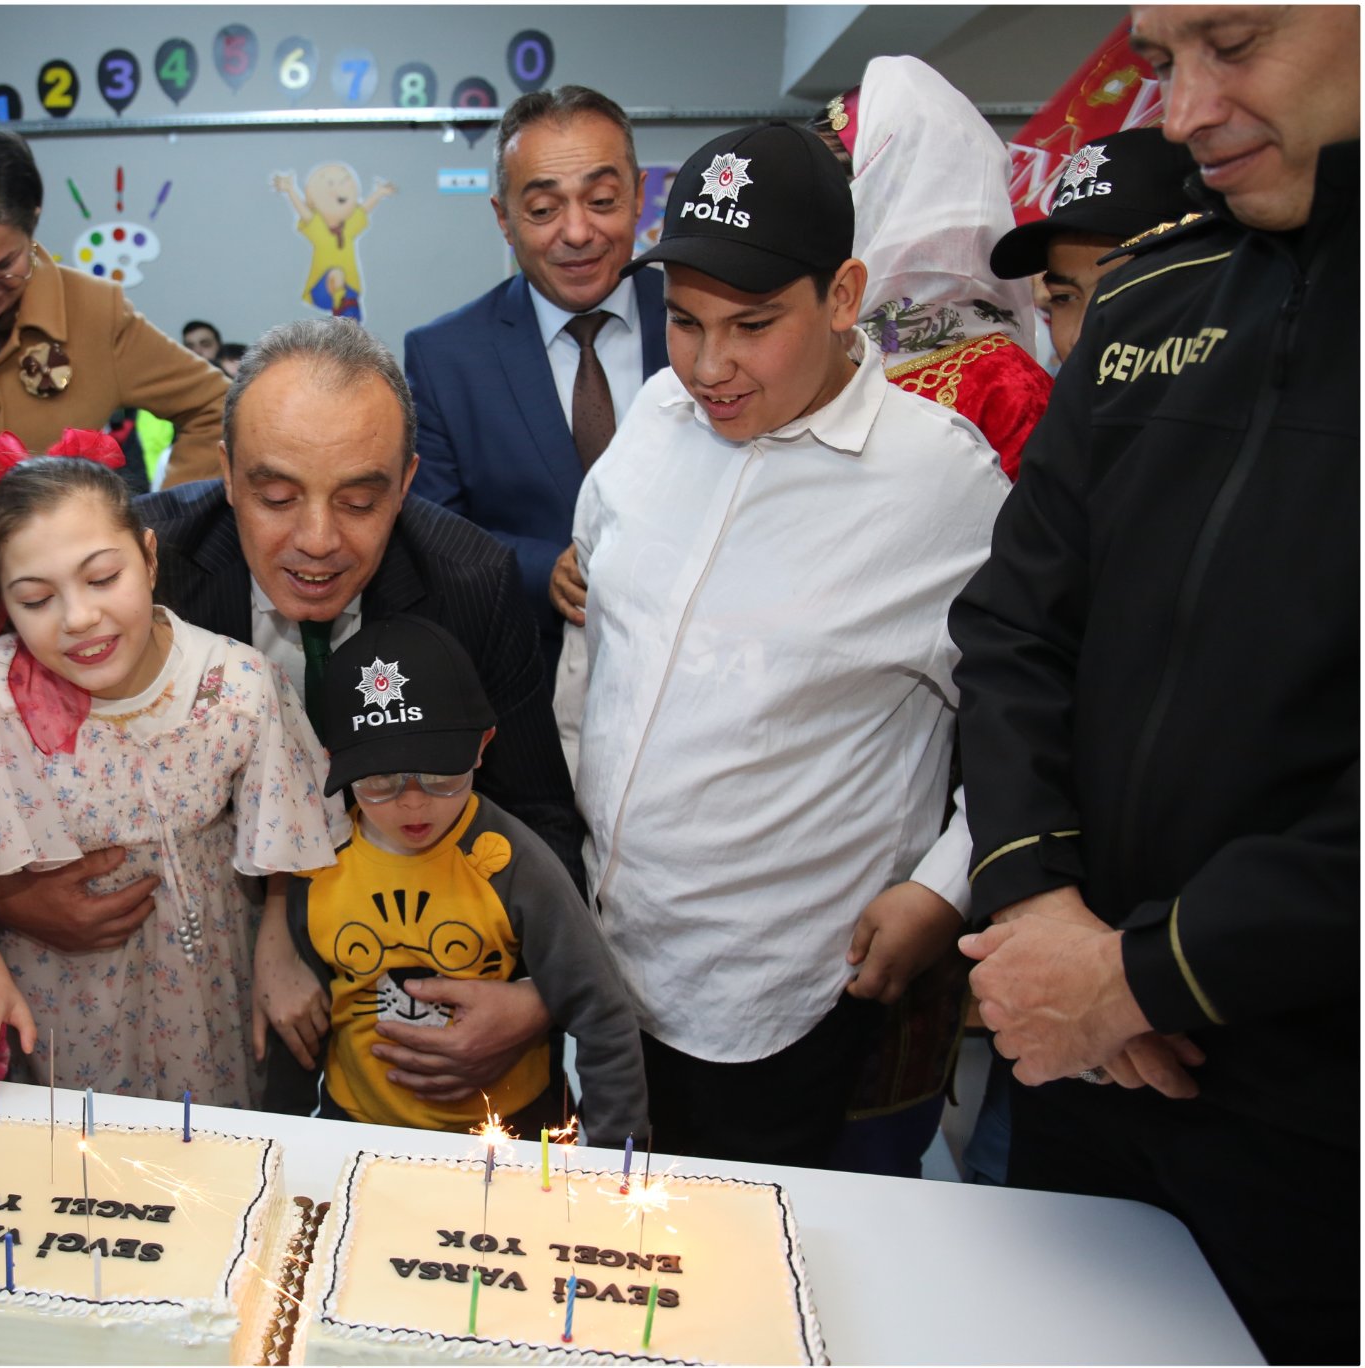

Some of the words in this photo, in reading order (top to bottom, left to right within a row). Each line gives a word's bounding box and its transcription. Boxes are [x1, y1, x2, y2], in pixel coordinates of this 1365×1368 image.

[43, 67, 73, 108] 2
[105, 59, 134, 99] 3
[160, 48, 191, 89] 4
[224, 35, 249, 75] 5
[279, 47, 310, 89] 6
[341, 60, 369, 100] 7
[515, 39, 546, 81] 0
[436, 1230, 527, 1256] YOK
